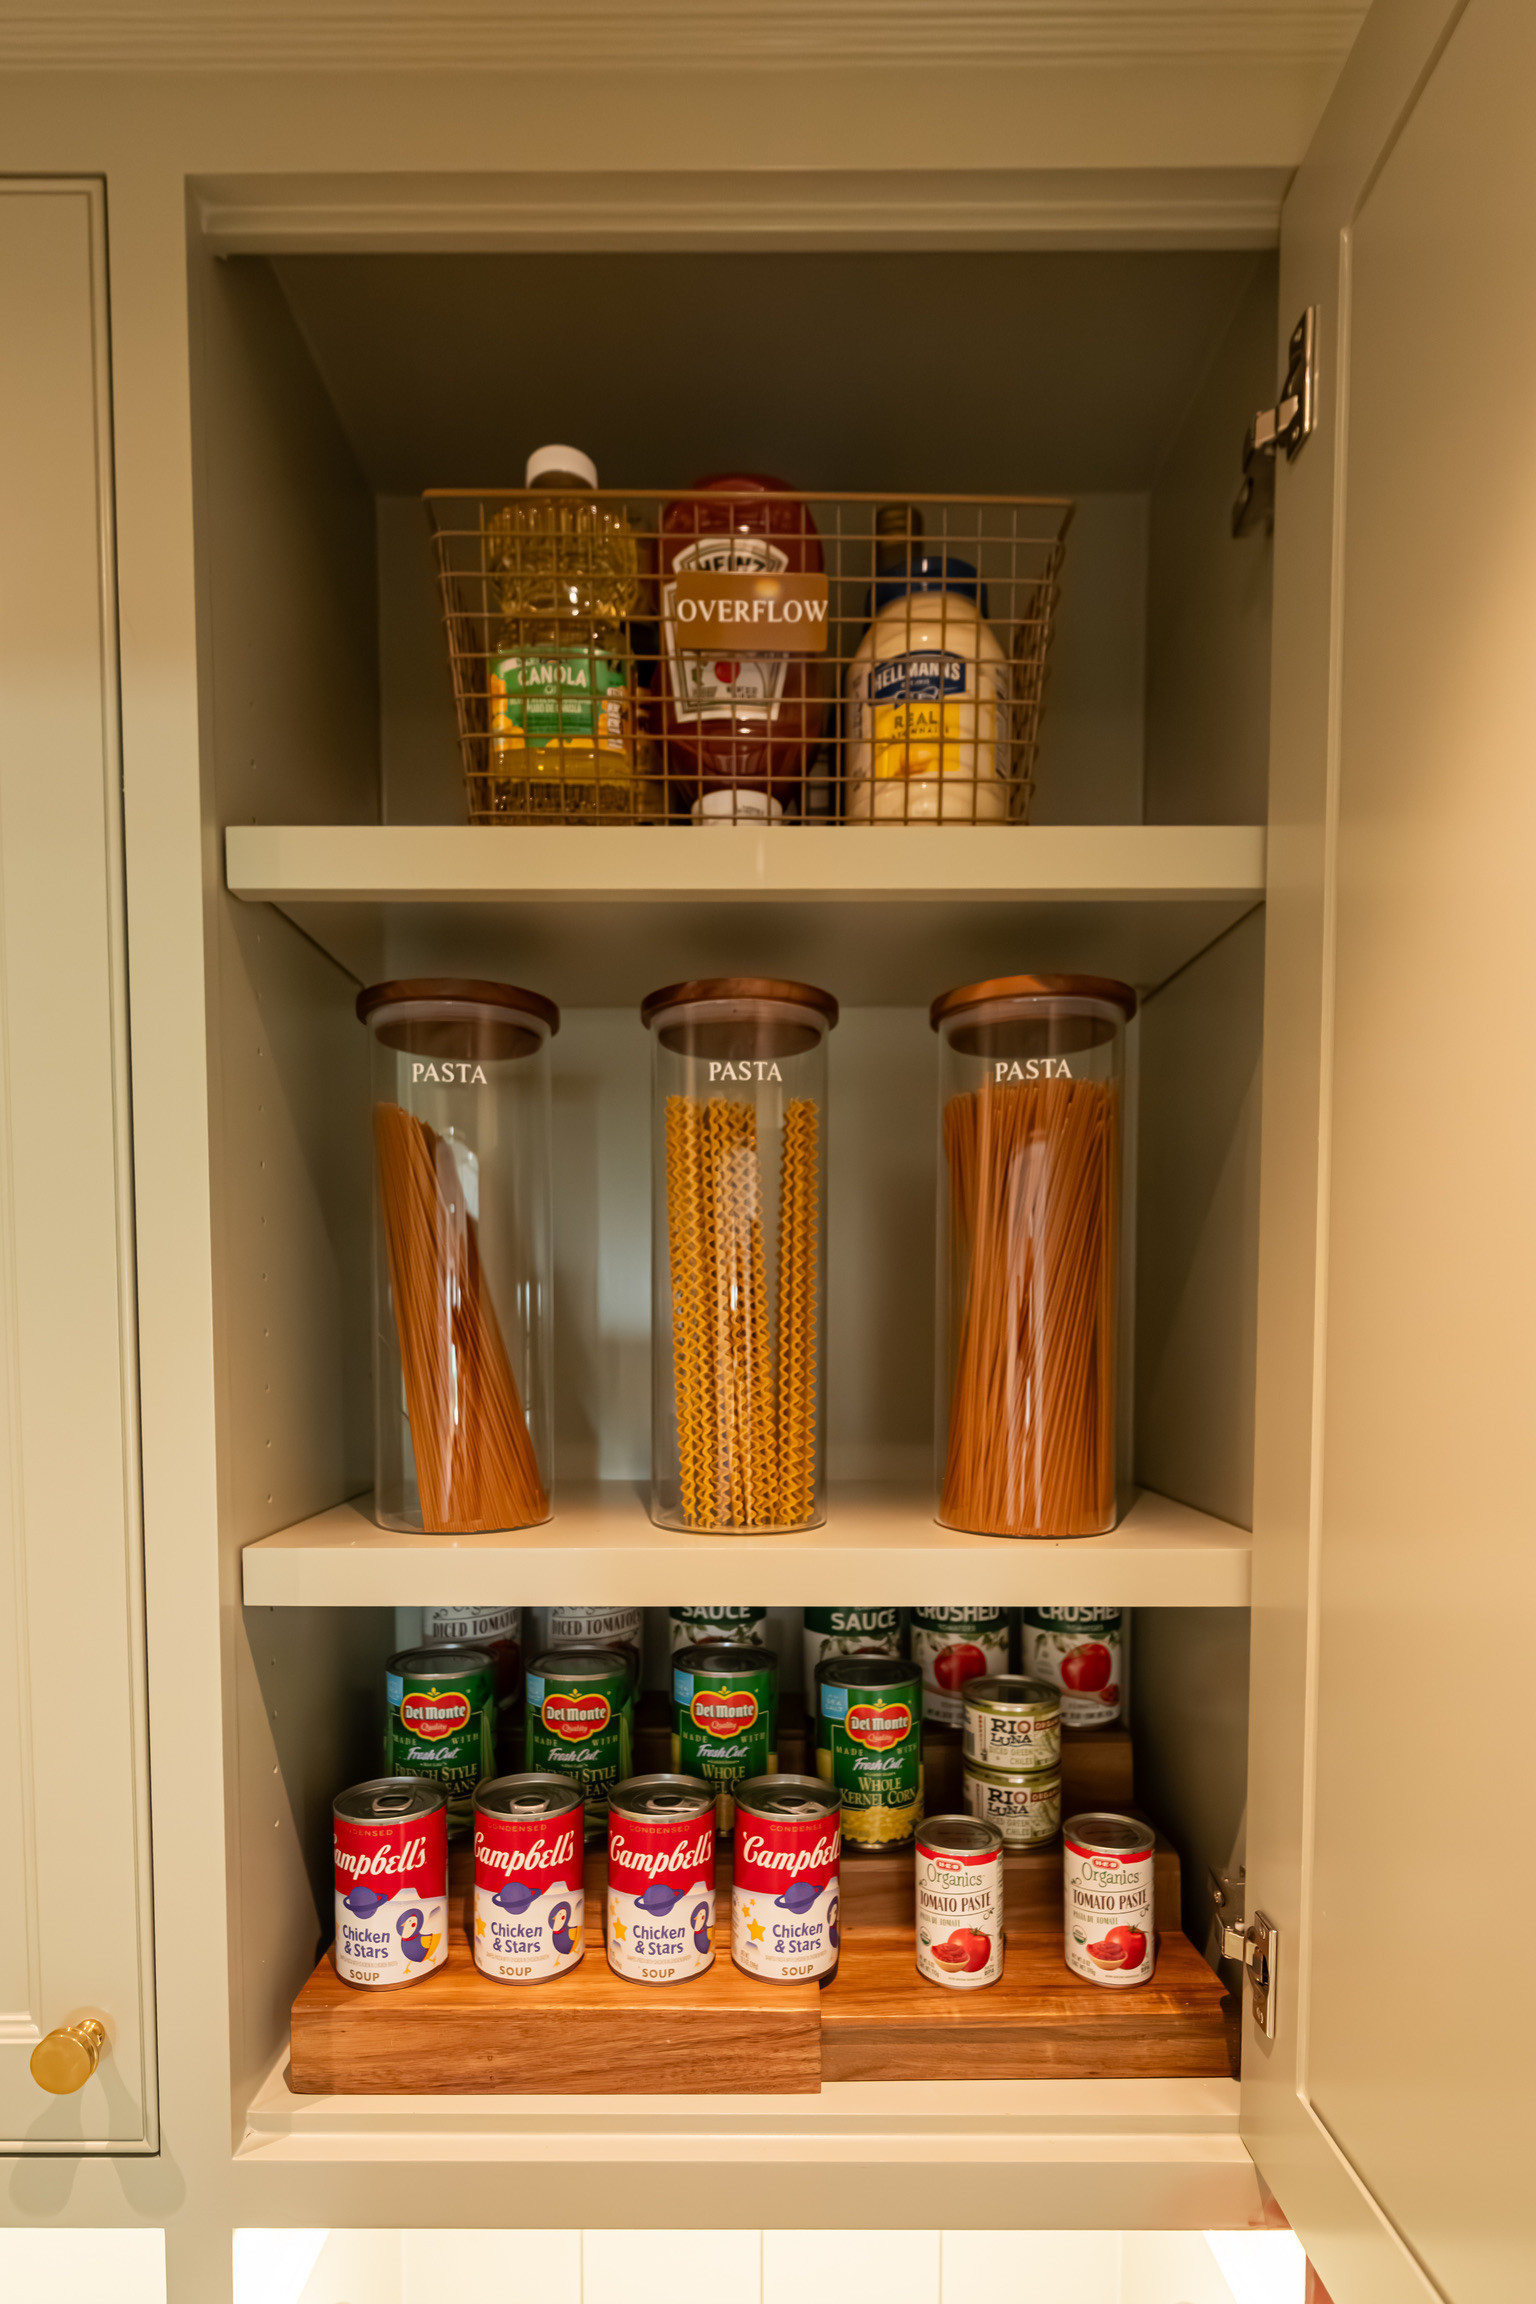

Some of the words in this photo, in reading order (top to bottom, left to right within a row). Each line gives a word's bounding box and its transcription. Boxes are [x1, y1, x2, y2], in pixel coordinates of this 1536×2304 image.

[677, 599, 829, 623] OVERFLOW
[518, 665, 587, 688] CANOLA
[894, 711, 938, 729] REAL
[412, 1063, 487, 1084] PASTA
[709, 1061, 782, 1081] PASTA
[995, 1058, 1072, 1082] PASTA
[831, 1609, 896, 1631] SAUCE
[916, 1607, 1001, 1621] CRUSHED
[433, 1621, 467, 1638] DICED
[552, 1619, 582, 1636] DICED
[405, 1706, 424, 1719] Del
[425, 1705, 466, 1720] Monte
[547, 1706, 564, 1720] Del
[566, 1707, 607, 1721] Monte
[695, 1703, 714, 1716] Del
[716, 1705, 755, 1718] Monte
[851, 1716, 871, 1730] Del
[872, 1717, 908, 1731] Monte
[991, 1718, 1031, 1735] RIO
[683, 1731, 709, 1743] MADE
[740, 1732, 766, 1743] WITH
[991, 1733, 1032, 1746] LUNA
[406, 1747, 435, 1761] Fresh
[434, 1747, 461, 1761] Cut
[548, 1748, 575, 1762] Fresh
[575, 1748, 602, 1762] Cut
[696, 1744, 725, 1758] Fresh
[725, 1745, 750, 1758] Cut
[836, 1746, 864, 1756] MADE
[702, 1764, 745, 1779] WHOLE
[853, 1757, 882, 1771] Fresh
[882, 1758, 905, 1771] Cut
[441, 1763, 478, 1781] STYLE
[582, 1765, 617, 1782] STYLE
[446, 1778, 476, 1794] EANS
[858, 1777, 902, 1792] WHOLE
[840, 1787, 886, 1806] KERNEL
[988, 1787, 1028, 1804] RIO
[987, 1802, 1029, 1816] LUNA
[629, 1825, 690, 1834] CONDENSED
[334, 1837, 426, 1880] ampbell's
[474, 1830, 574, 1877] Campbell's
[610, 1830, 712, 1879] Campbell's
[927, 1863, 982, 1889] Organics
[1082, 1862, 1139, 1888] Organics
[921, 1891, 957, 1912] TOMATO
[962, 1891, 991, 1912] PASTE
[1073, 1889, 1115, 1910] TOMATO
[1119, 1889, 1147, 1910] PASTE
[343, 1924, 390, 1943] Chicken
[491, 1922, 542, 1938] Chicken
[633, 1925, 685, 1940] Chicken
[772, 1923, 823, 1938] Chicken
[344, 1941, 352, 1956] &
[354, 1943, 388, 1958] Stars
[493, 1938, 502, 1952] &
[505, 1939, 541, 1953] Stars
[635, 1940, 645, 1954] &
[648, 1941, 684, 1955] Stars
[774, 1939, 785, 1953] &
[789, 1938, 821, 1953] Stars
[350, 1969, 380, 1981] SOUP
[499, 1966, 532, 1976] SOUP
[642, 1968, 675, 1978] SOUP
[782, 1964, 814, 1976] SOUP
